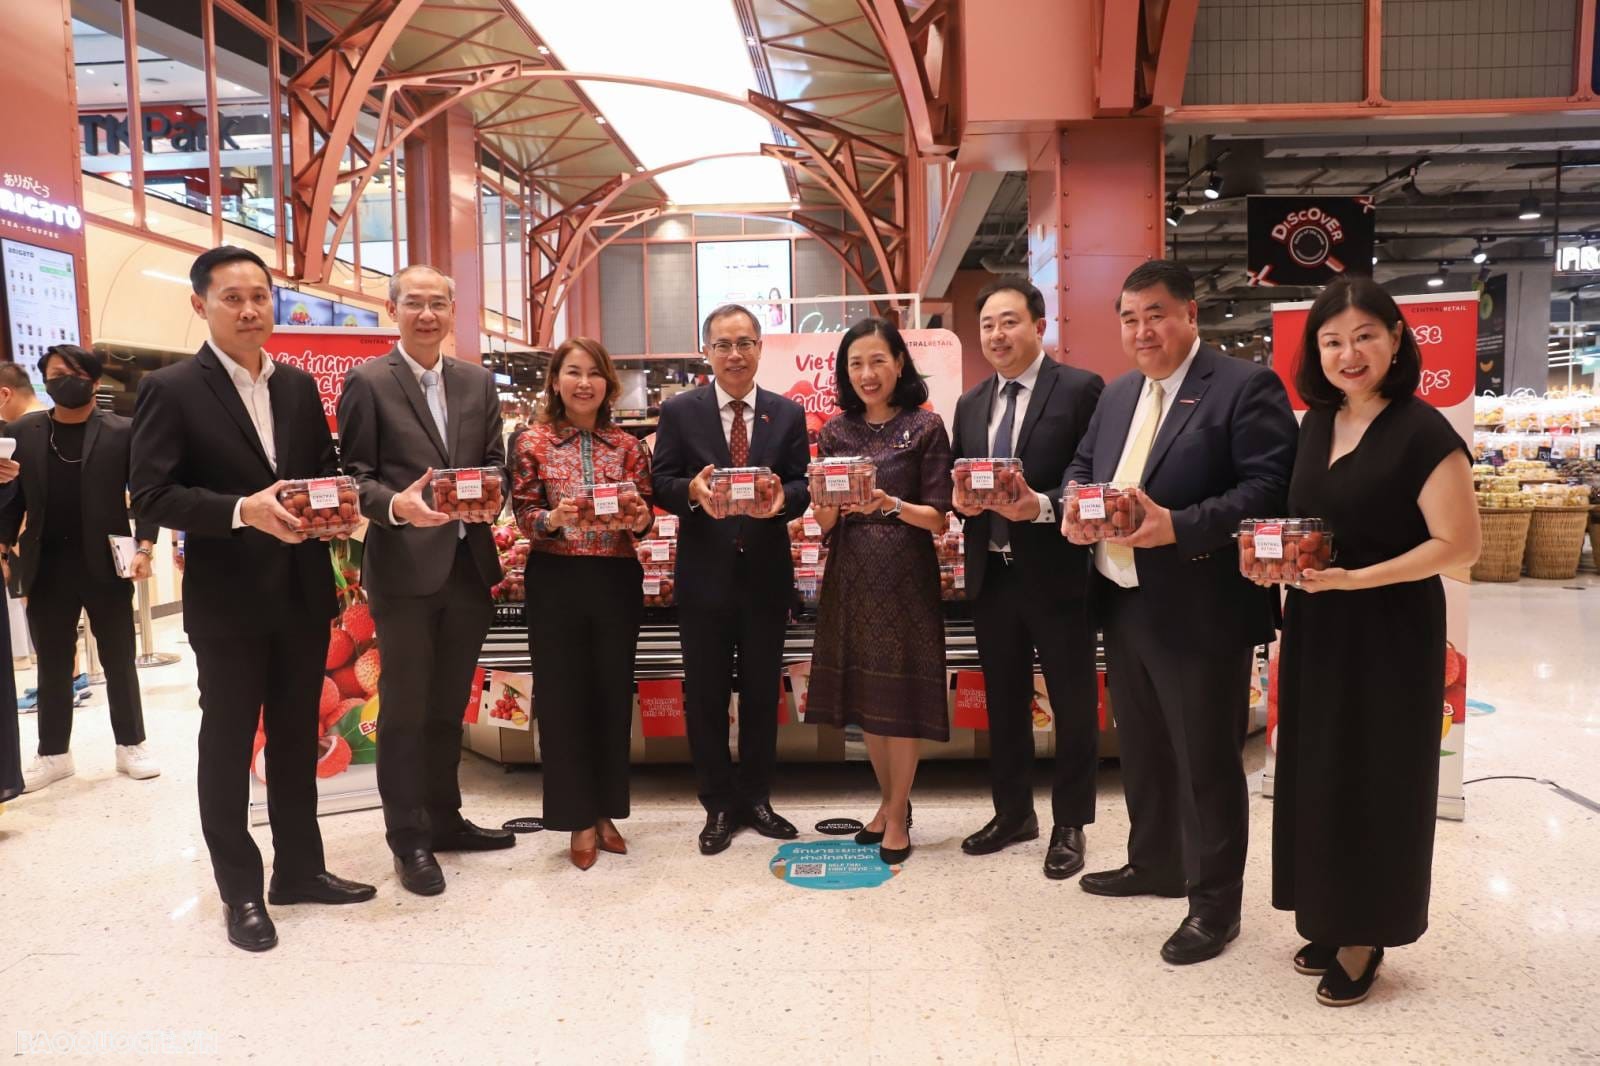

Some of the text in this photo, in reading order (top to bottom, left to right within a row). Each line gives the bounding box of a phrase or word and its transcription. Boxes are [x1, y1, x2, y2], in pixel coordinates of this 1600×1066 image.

[4, 173, 50, 198] ありがとう
[1271, 207, 1343, 241] DISCOVER
